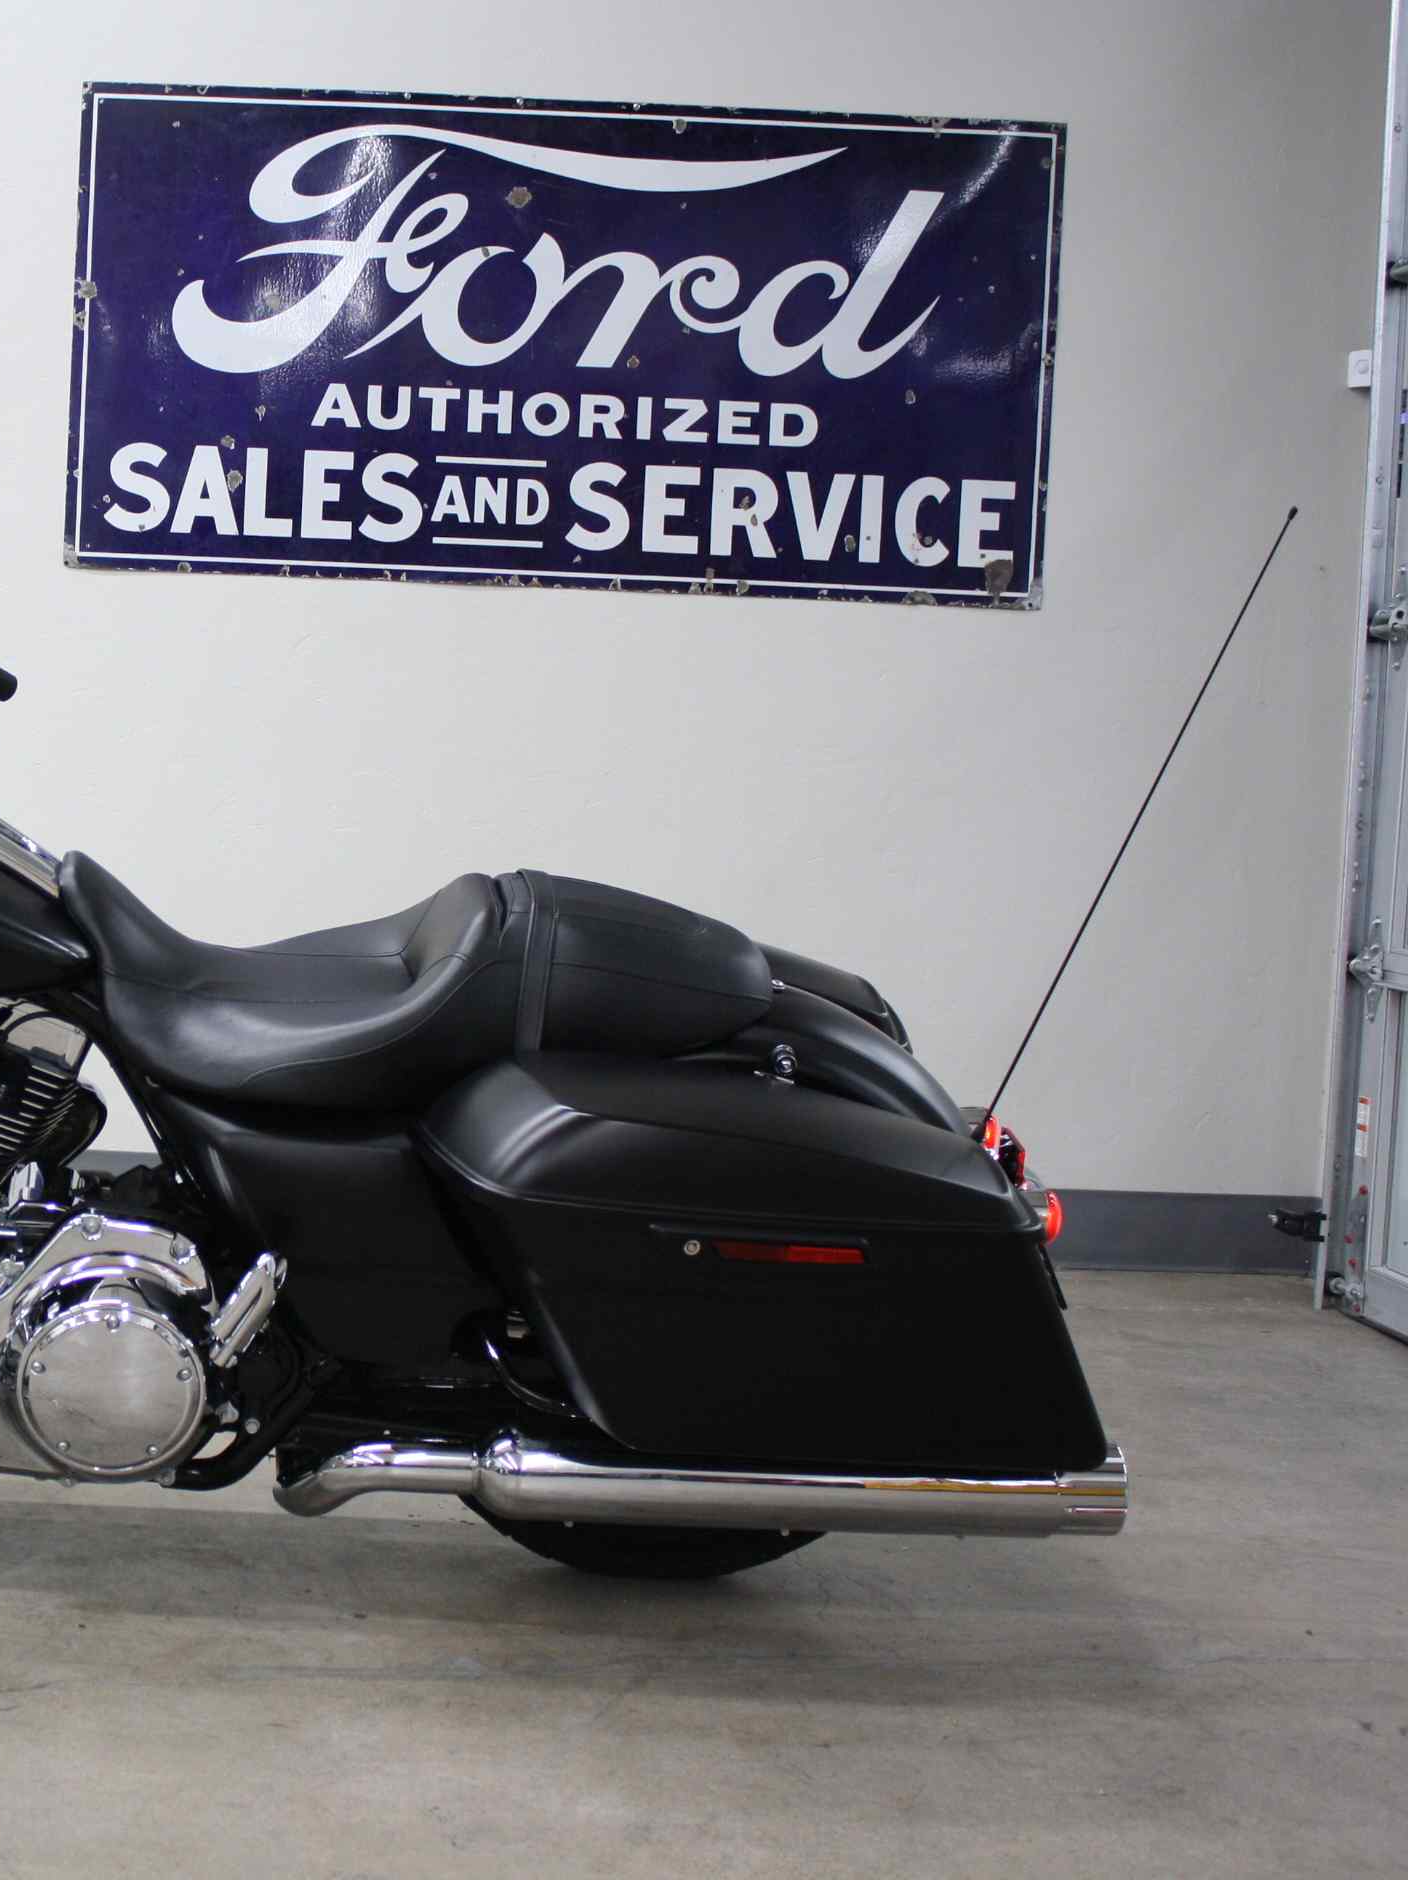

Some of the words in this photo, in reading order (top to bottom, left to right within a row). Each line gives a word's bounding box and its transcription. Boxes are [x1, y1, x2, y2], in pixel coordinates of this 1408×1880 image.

[171, 123, 946, 380] Ford
[310, 382, 819, 448] AUTHORIZED
[103, 441, 426, 545] SALES
[431, 473, 550, 527] AND
[565, 462, 1019, 568] SERVICE
